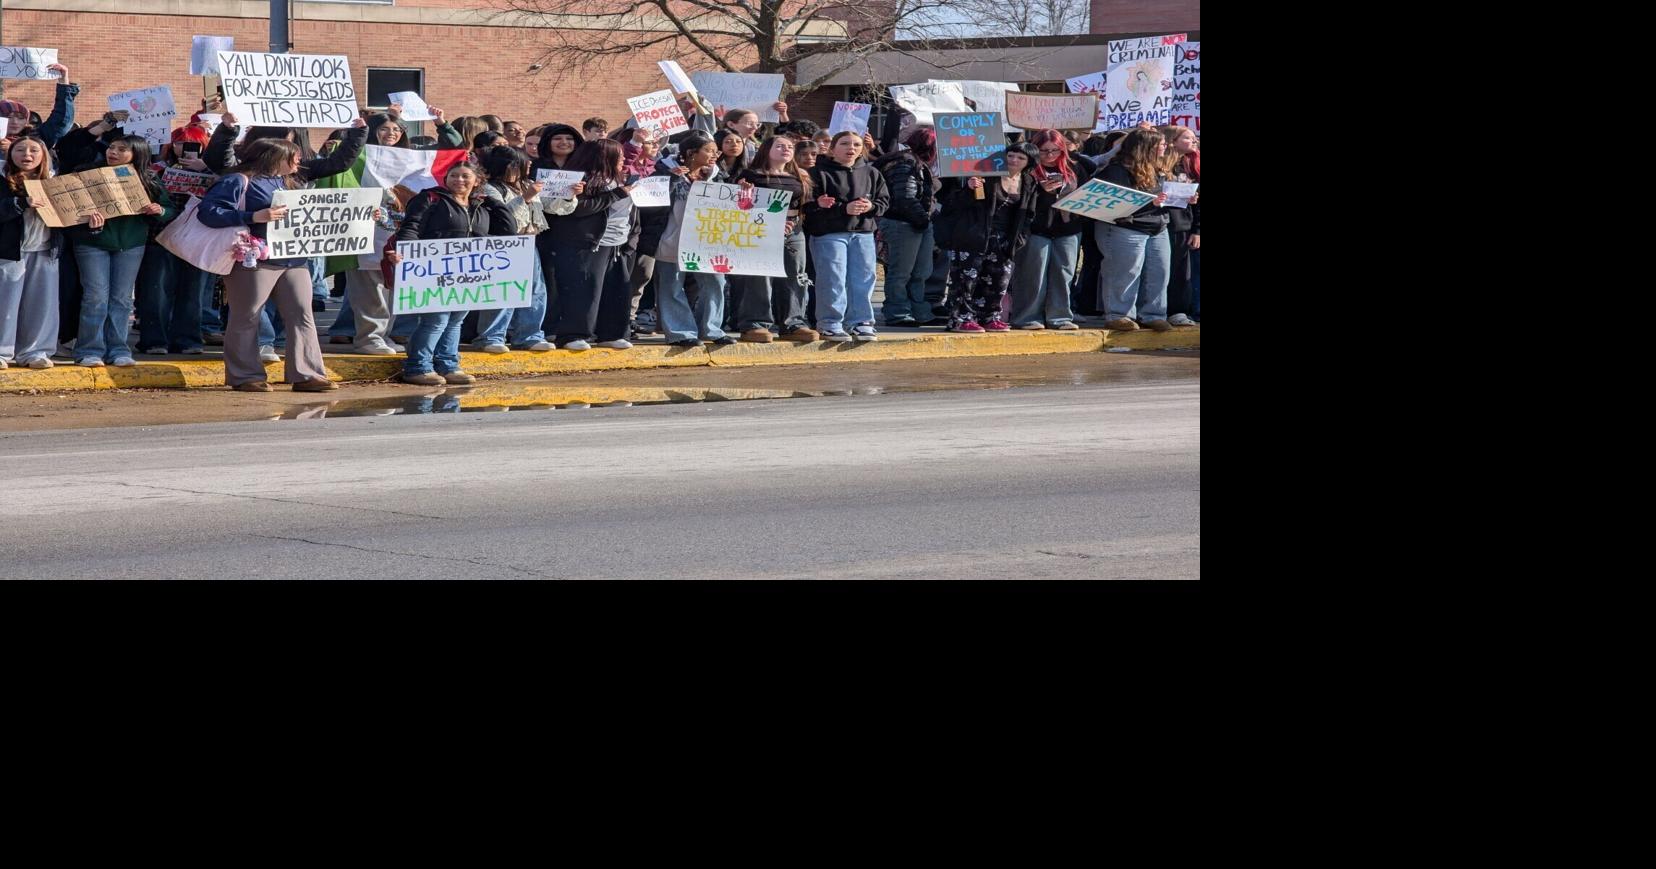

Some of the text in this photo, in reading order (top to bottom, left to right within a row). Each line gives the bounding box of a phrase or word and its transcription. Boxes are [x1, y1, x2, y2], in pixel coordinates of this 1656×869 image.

[1110, 40, 1132, 52] WE
[1138, 37, 1160, 49] ARE
[220, 53, 346, 79] YALL DONT LOOK
[225, 79, 354, 101] FOR MISSIG KIDS
[244, 101, 353, 124] THIS HARD
[635, 104, 680, 123] PROTECT
[1107, 96, 1172, 114] We Ar
[939, 113, 996, 130] COMPLY
[1107, 109, 1170, 131] DREAME
[959, 128, 976, 137] OR
[942, 147, 957, 157] IN
[959, 146, 982, 155] THE
[299, 193, 349, 206] SANGRE
[696, 183, 713, 198] I
[1083, 181, 1150, 206] ABOLISH
[1060, 200, 1100, 213] FDT
[1080, 193, 1121, 210] ICE
[274, 205, 374, 230] MEXICANA
[694, 208, 751, 223] LIBERTY
[695, 220, 768, 238] JUSTICE
[272, 236, 368, 257] MEXICANO
[443, 239, 482, 255] ISNT
[485, 237, 529, 251] ABOUT
[698, 231, 760, 248] FOR ALL
[401, 250, 511, 281] POLITICS
[456, 272, 491, 285] about
[398, 279, 529, 311] HUMANITY
